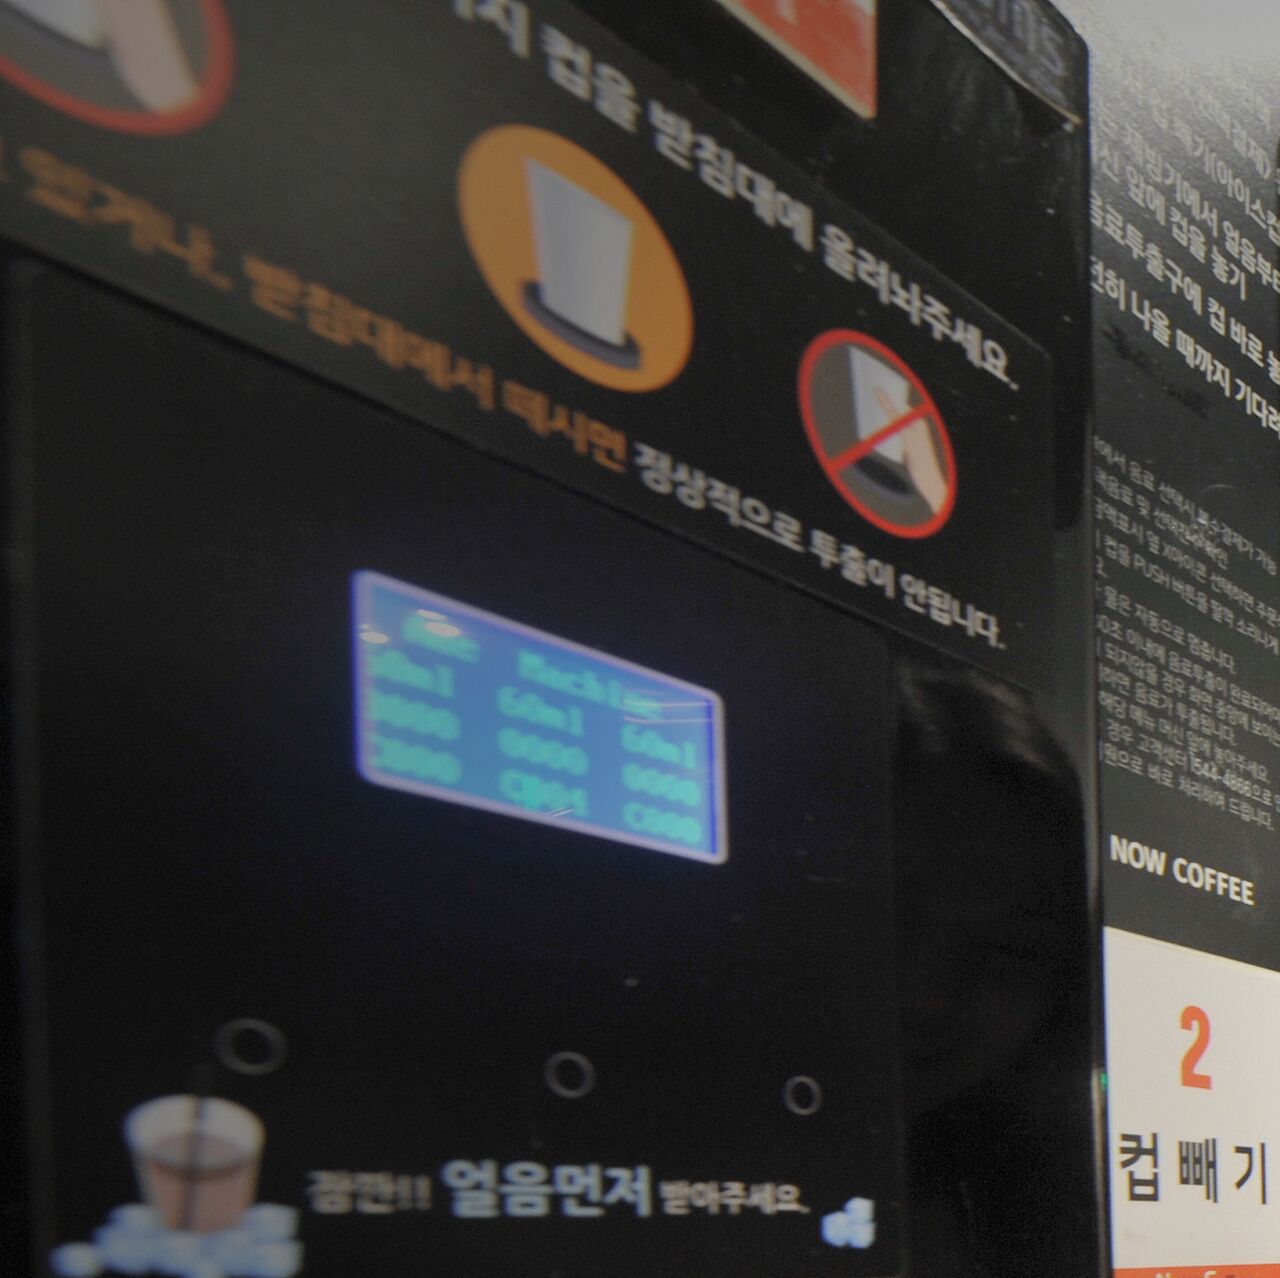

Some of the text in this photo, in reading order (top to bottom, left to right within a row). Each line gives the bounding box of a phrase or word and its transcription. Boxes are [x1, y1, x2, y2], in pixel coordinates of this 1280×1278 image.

[541, 25, 643, 134] 컵을
[647, 99, 815, 253] 받침대에
[1169, 206, 1207, 265] 컵을
[1211, 246, 1247, 301] 놓기
[1131, 290, 1172, 349] 나올
[1175, 328, 1232, 398] 때까지
[1208, 297, 1226, 338] 컵
[1230, 317, 1264, 369] 바로
[633, 441, 803, 553] 정상적으로
[1110, 834, 1255, 906] NOW COFFEE
[1180, 1005, 1212, 1090] 2
[440, 1156, 655, 1222] 얼음먼저
[1119, 1132, 1160, 1205] 컵
